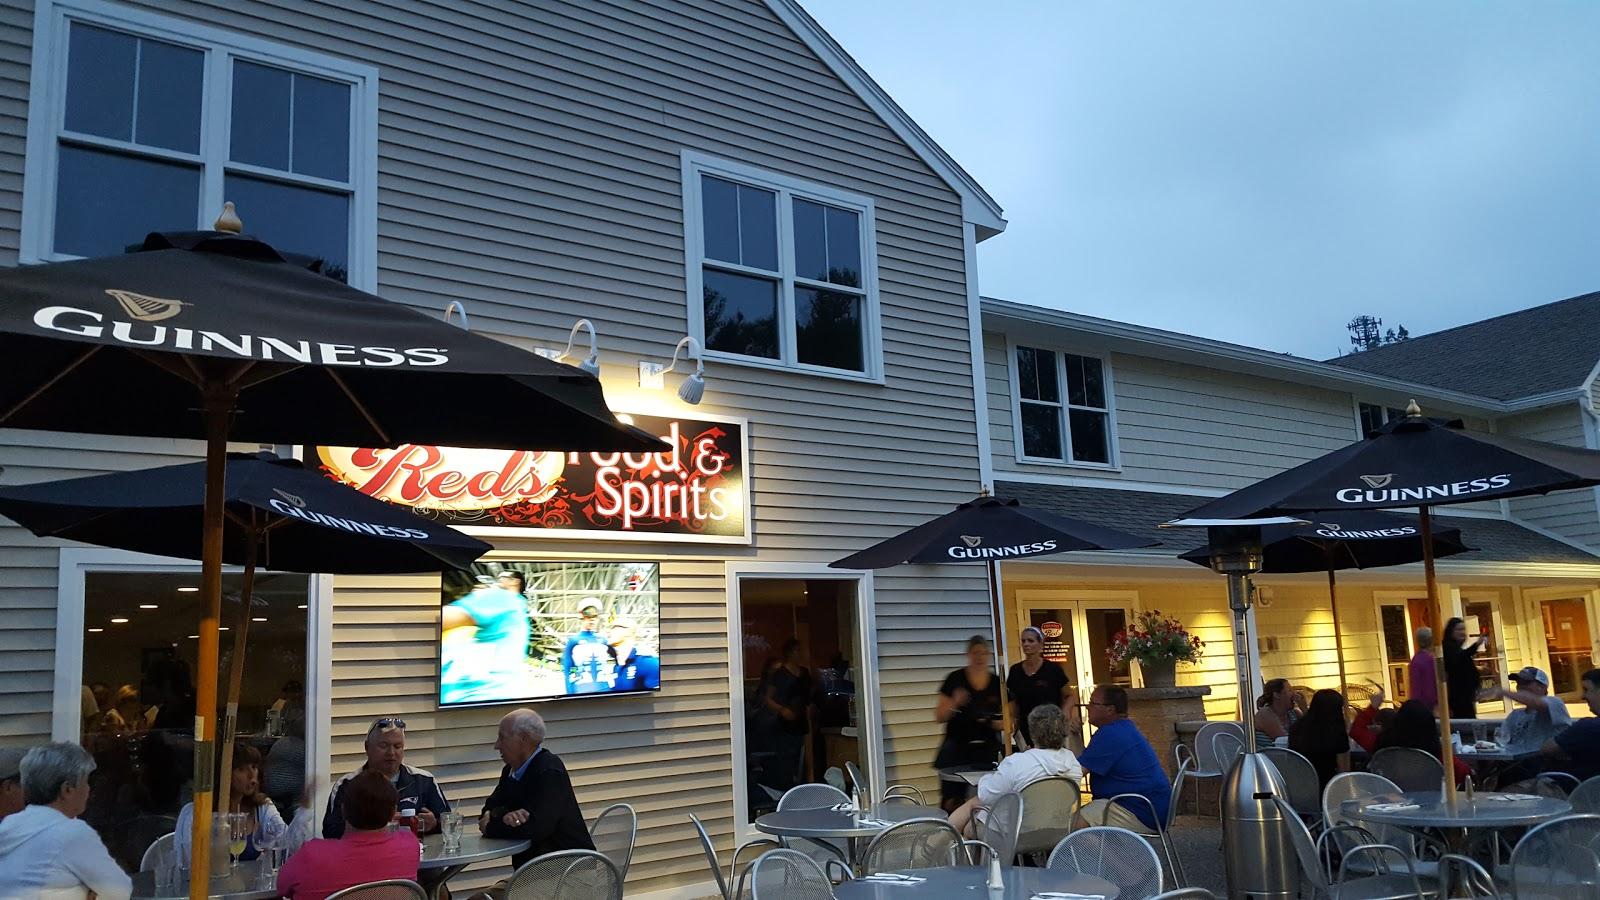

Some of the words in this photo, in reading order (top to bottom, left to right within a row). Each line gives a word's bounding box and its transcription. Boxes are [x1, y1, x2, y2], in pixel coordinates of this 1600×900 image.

[33, 305, 449, 367] GUINNESS
[696, 438, 725, 476] &
[596, 466, 729, 528] Spirits
[1336, 473, 1511, 503] GUINNESS
[269, 498, 429, 539] GUINNESS
[1316, 526, 1417, 539] GUINNESS
[948, 539, 1057, 558] GUINNESS
